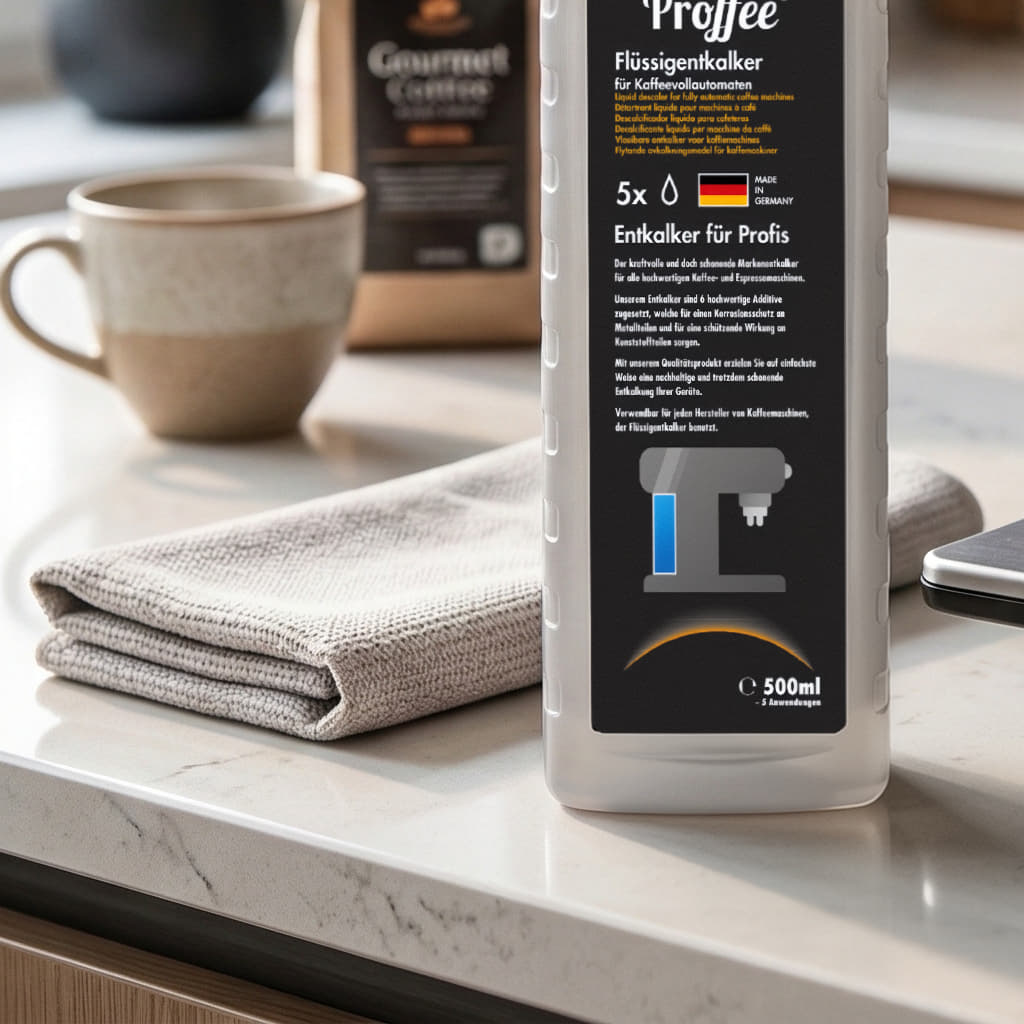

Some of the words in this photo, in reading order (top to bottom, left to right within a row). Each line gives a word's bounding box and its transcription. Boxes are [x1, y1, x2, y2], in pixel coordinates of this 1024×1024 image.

[368, 41, 510, 79] Gourmet
[616, 50, 763, 76] Flüssigentkalker
[615, 77, 631, 90] für
[635, 77, 752, 90] Kaffeevollautomaten
[617, 181, 647, 205] 5x
[755, 186, 763, 194] IN
[755, 197, 793, 205] GERMANY
[615, 223, 700, 243] Entkalker
[706, 223, 732, 243] für
[739, 223, 789, 243] Profis
[764, 677, 820, 695] 500ml
[762, 698, 766, 706] 5
[769, 698, 821, 708] Anwendungen
